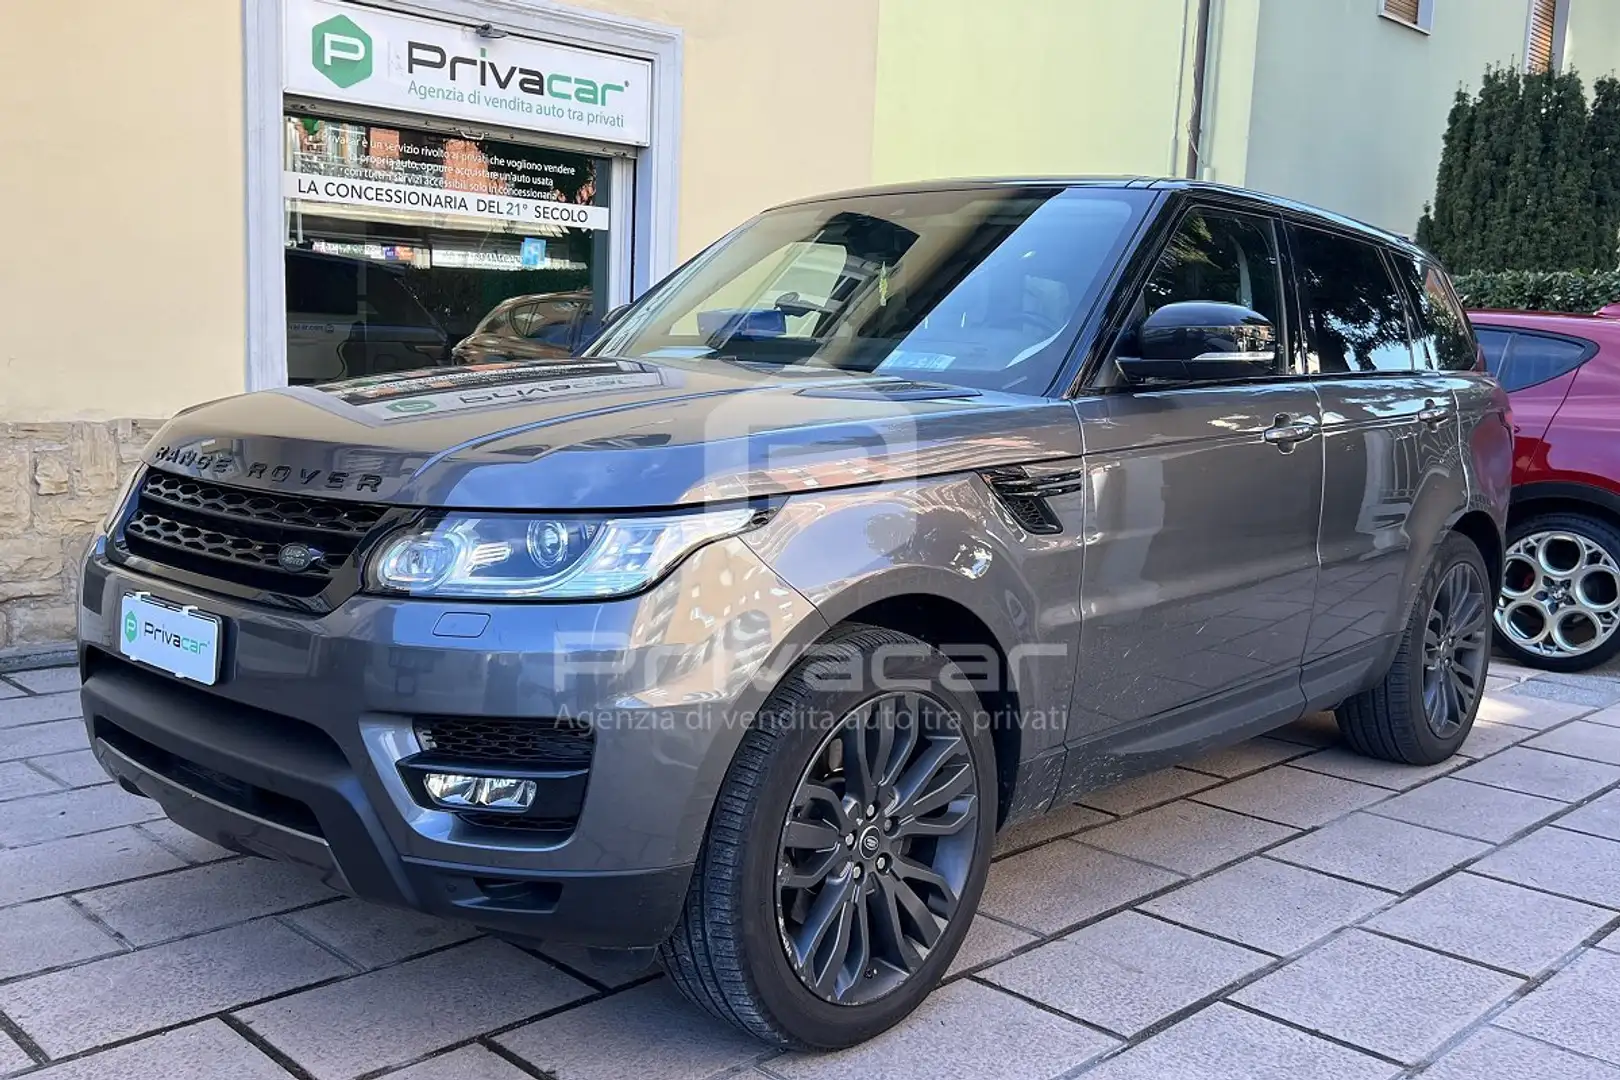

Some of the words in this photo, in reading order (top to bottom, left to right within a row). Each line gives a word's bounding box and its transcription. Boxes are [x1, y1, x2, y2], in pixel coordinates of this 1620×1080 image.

[407, 40, 629, 107] Privacar
[407, 79, 465, 103] Agenzia
[467, 88, 481, 105] di
[484, 95, 533, 114] vendita
[536, 104, 565, 119] auto
[567, 107, 584, 122] tra
[586, 112, 625, 129] privati
[360, 154, 393, 170] propria
[395, 159, 421, 171] auto,
[421, 162, 452, 176] oppure
[455, 165, 499, 180] acquistare
[499, 171, 531, 184] un'auto
[532, 176, 554, 187] usata
[385, 141, 420, 155] servizio
[421, 146, 449, 159] rivolto
[460, 151, 489, 164] privati
[490, 154, 505, 166] che
[506, 157, 543, 171] vogliono
[544, 164, 576, 176] vendere
[297, 178, 319, 196] LA
[323, 182, 469, 211] CONCESSIONARIA
[476, 199, 503, 215] DEL
[505, 201, 528, 215] 21°
[533, 205, 588, 223] SECOLO
[344, 168, 362, 178] con
[470, 181, 488, 193] solo
[498, 184, 558, 201] concessionaria
[155, 446, 232, 474] RANGE
[247, 463, 383, 493] ROVER
[143, 620, 208, 655] Privacar
